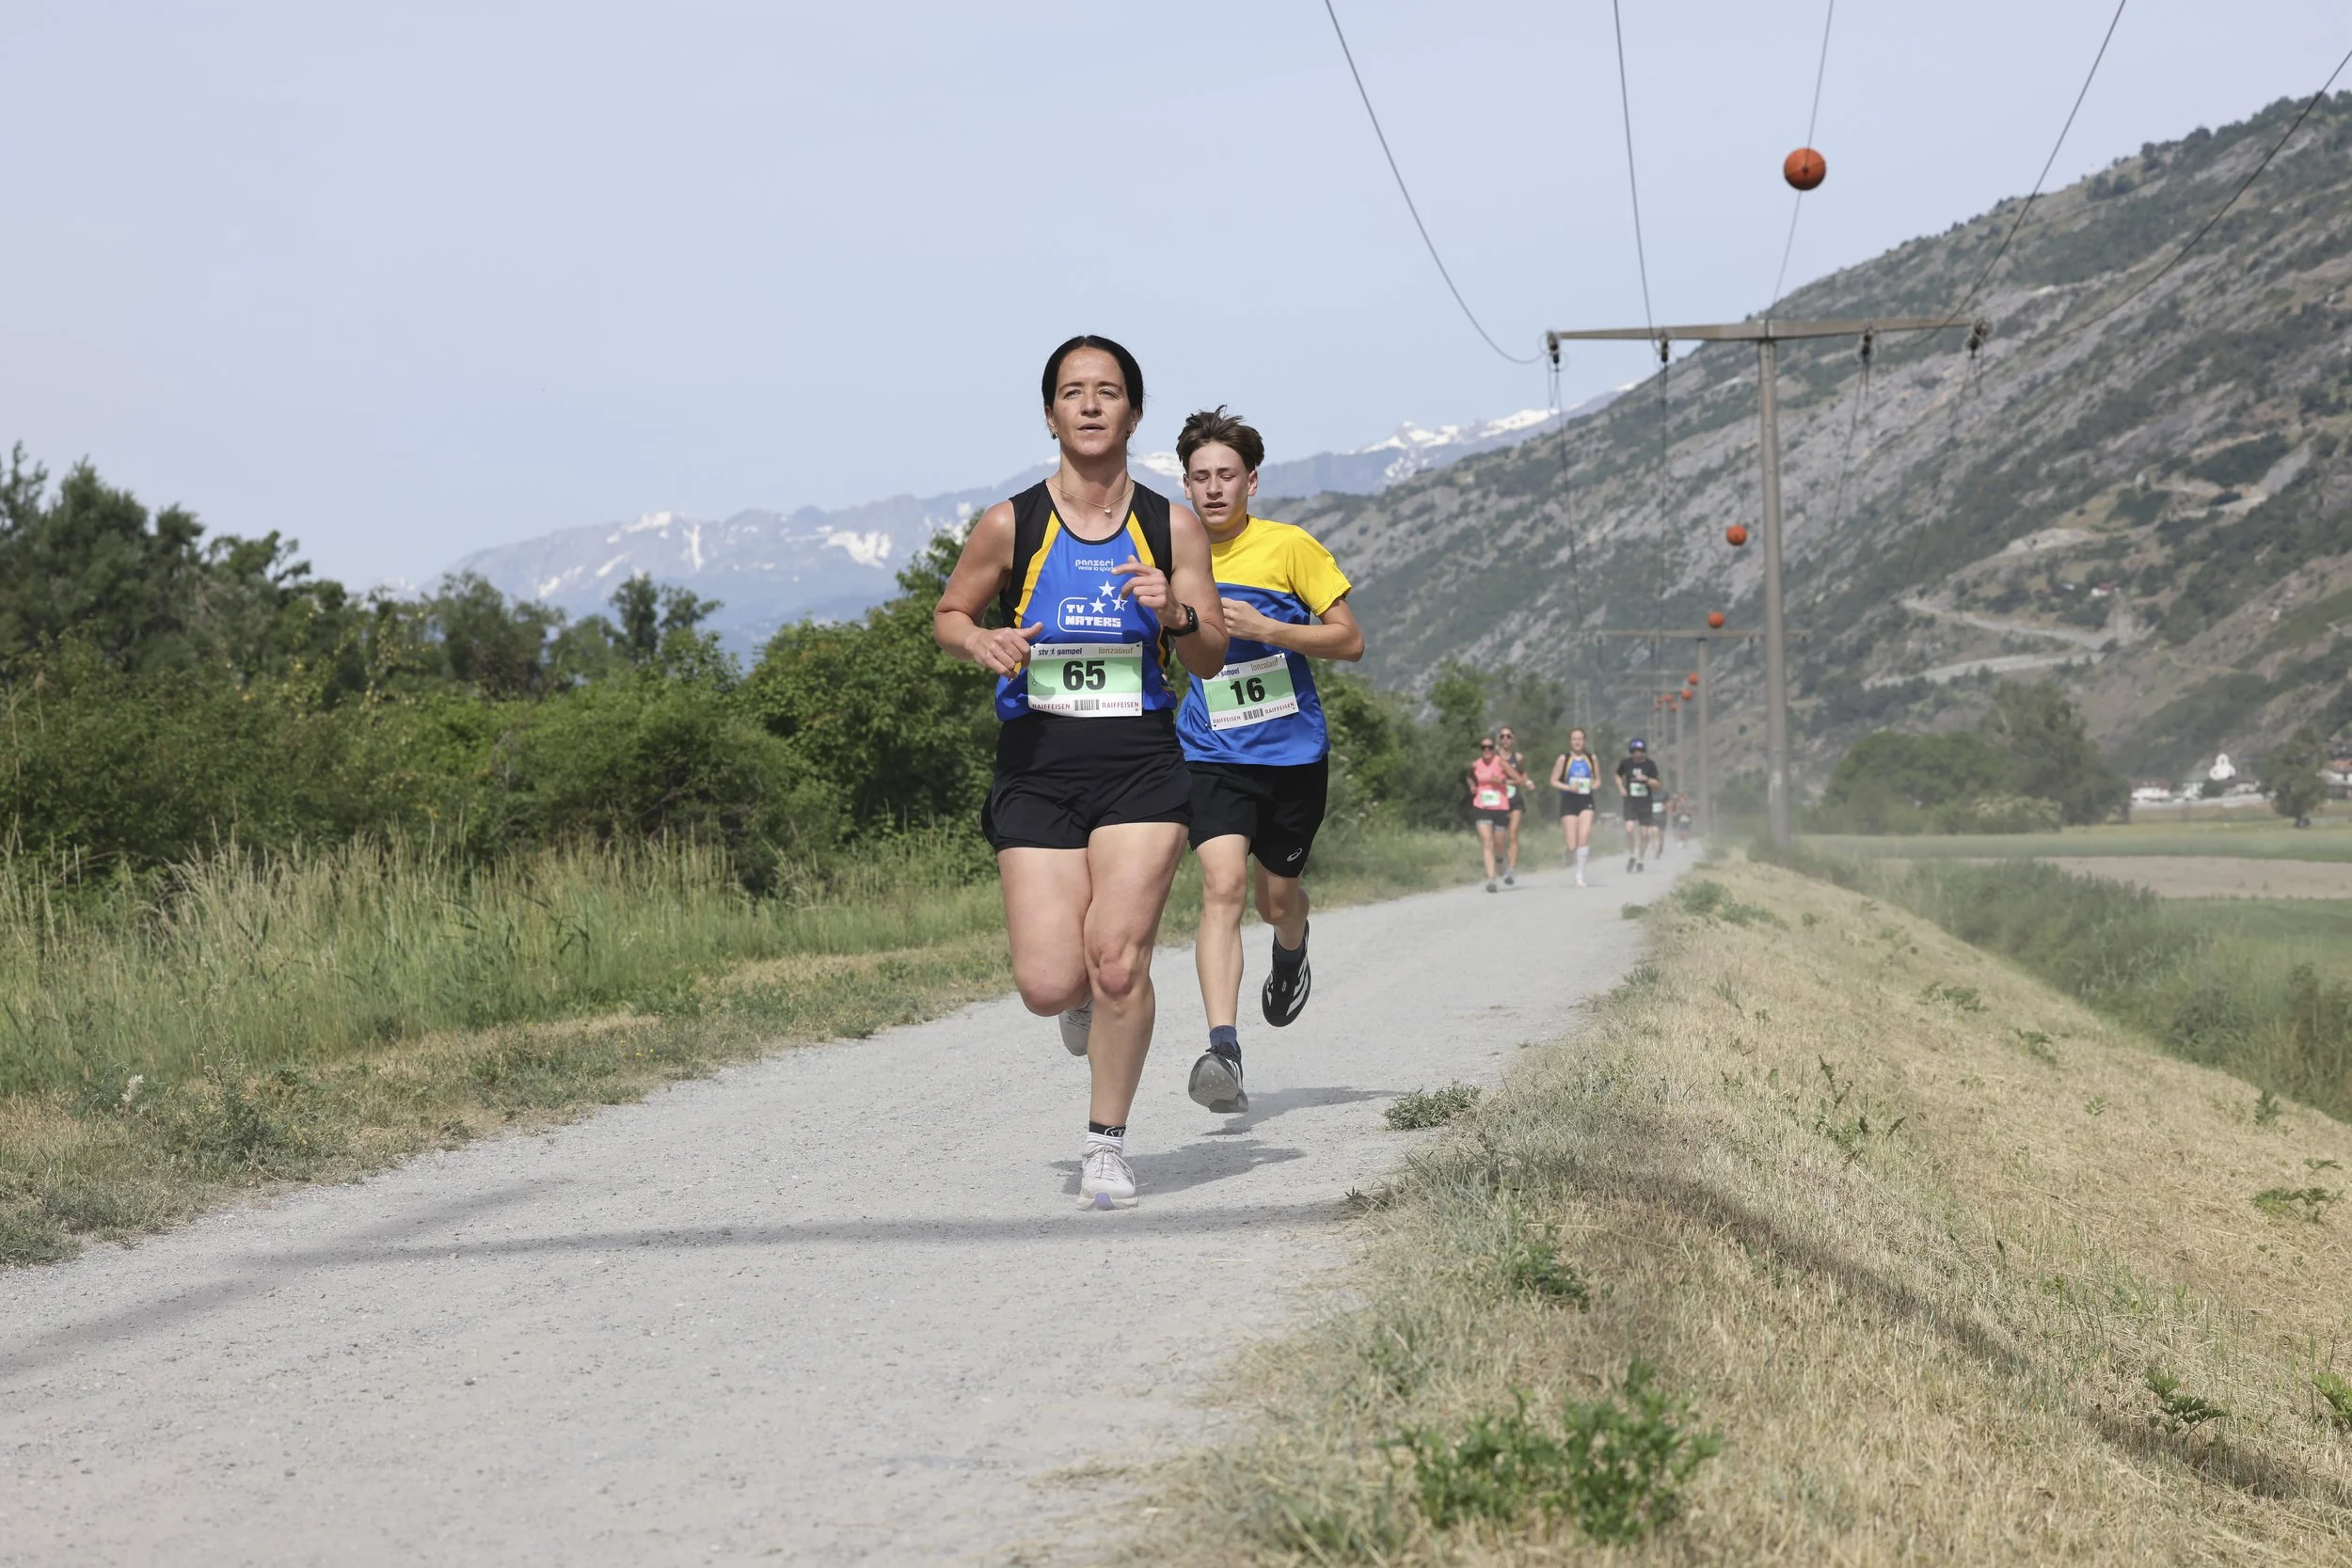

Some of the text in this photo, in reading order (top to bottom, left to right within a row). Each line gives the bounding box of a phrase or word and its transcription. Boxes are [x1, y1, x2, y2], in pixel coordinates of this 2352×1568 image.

[1074, 558, 1114, 567] panzeri
[1066, 604, 1085, 613] TV
[1065, 615, 1121, 628] NATERS
[1057, 647, 1083, 656] gampel
[1098, 646, 1134, 655] lonzalauf
[1250, 657, 1279, 672] lonzalauf
[1062, 659, 1106, 691] 65
[1230, 677, 1265, 705] 16
[1264, 703, 1295, 715] RAIFFEISEN
[1213, 715, 1242, 724] RAIFFEISEN
